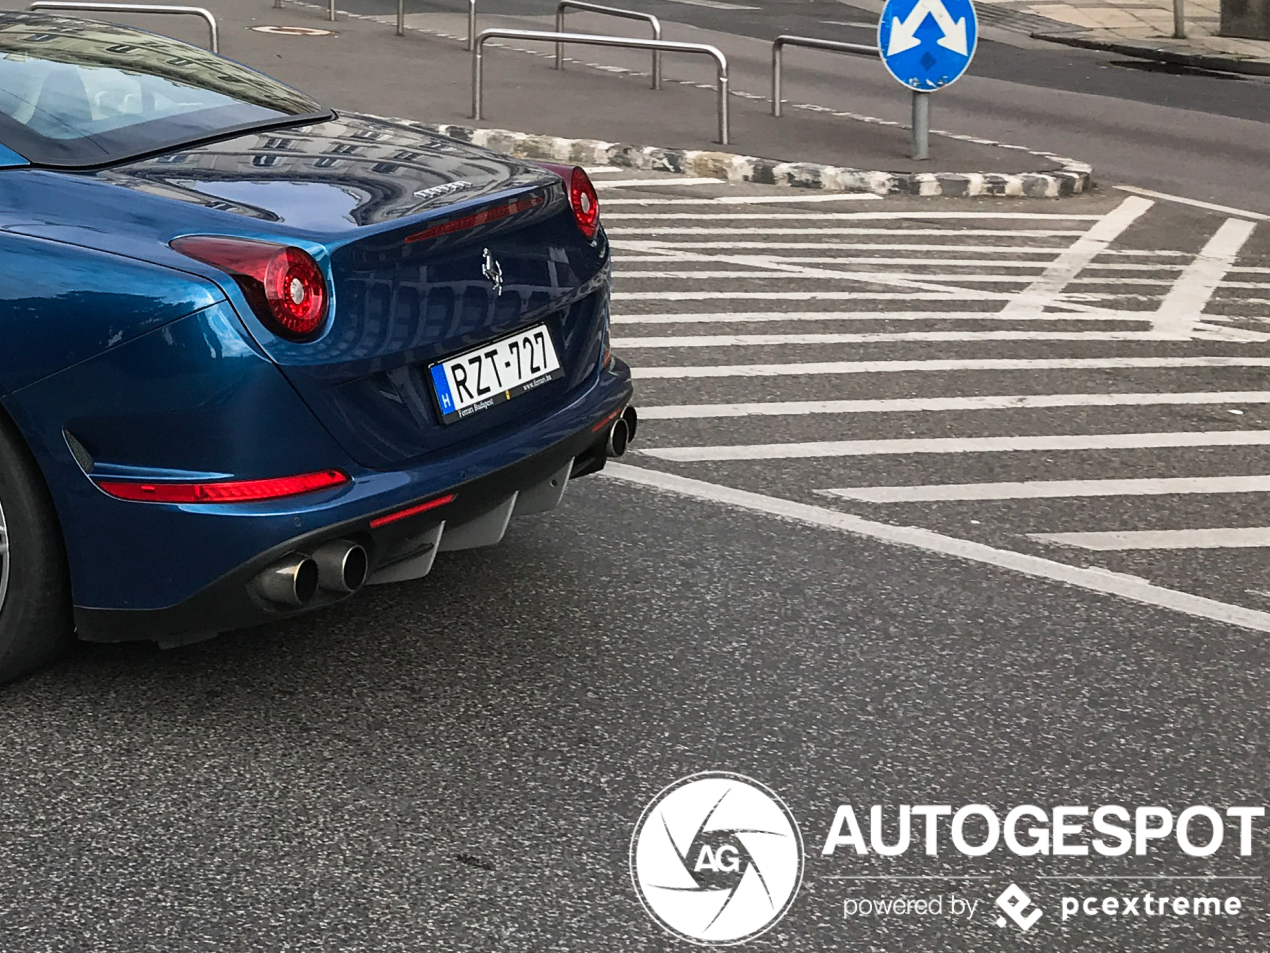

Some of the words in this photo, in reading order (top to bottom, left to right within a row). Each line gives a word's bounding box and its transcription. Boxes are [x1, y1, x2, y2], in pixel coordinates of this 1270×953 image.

[450, 331, 548, 404] RZT-727
[441, 393, 451, 408] H
[457, 408, 475, 418] Ferrari
[473, 398, 494, 412] Budapest
